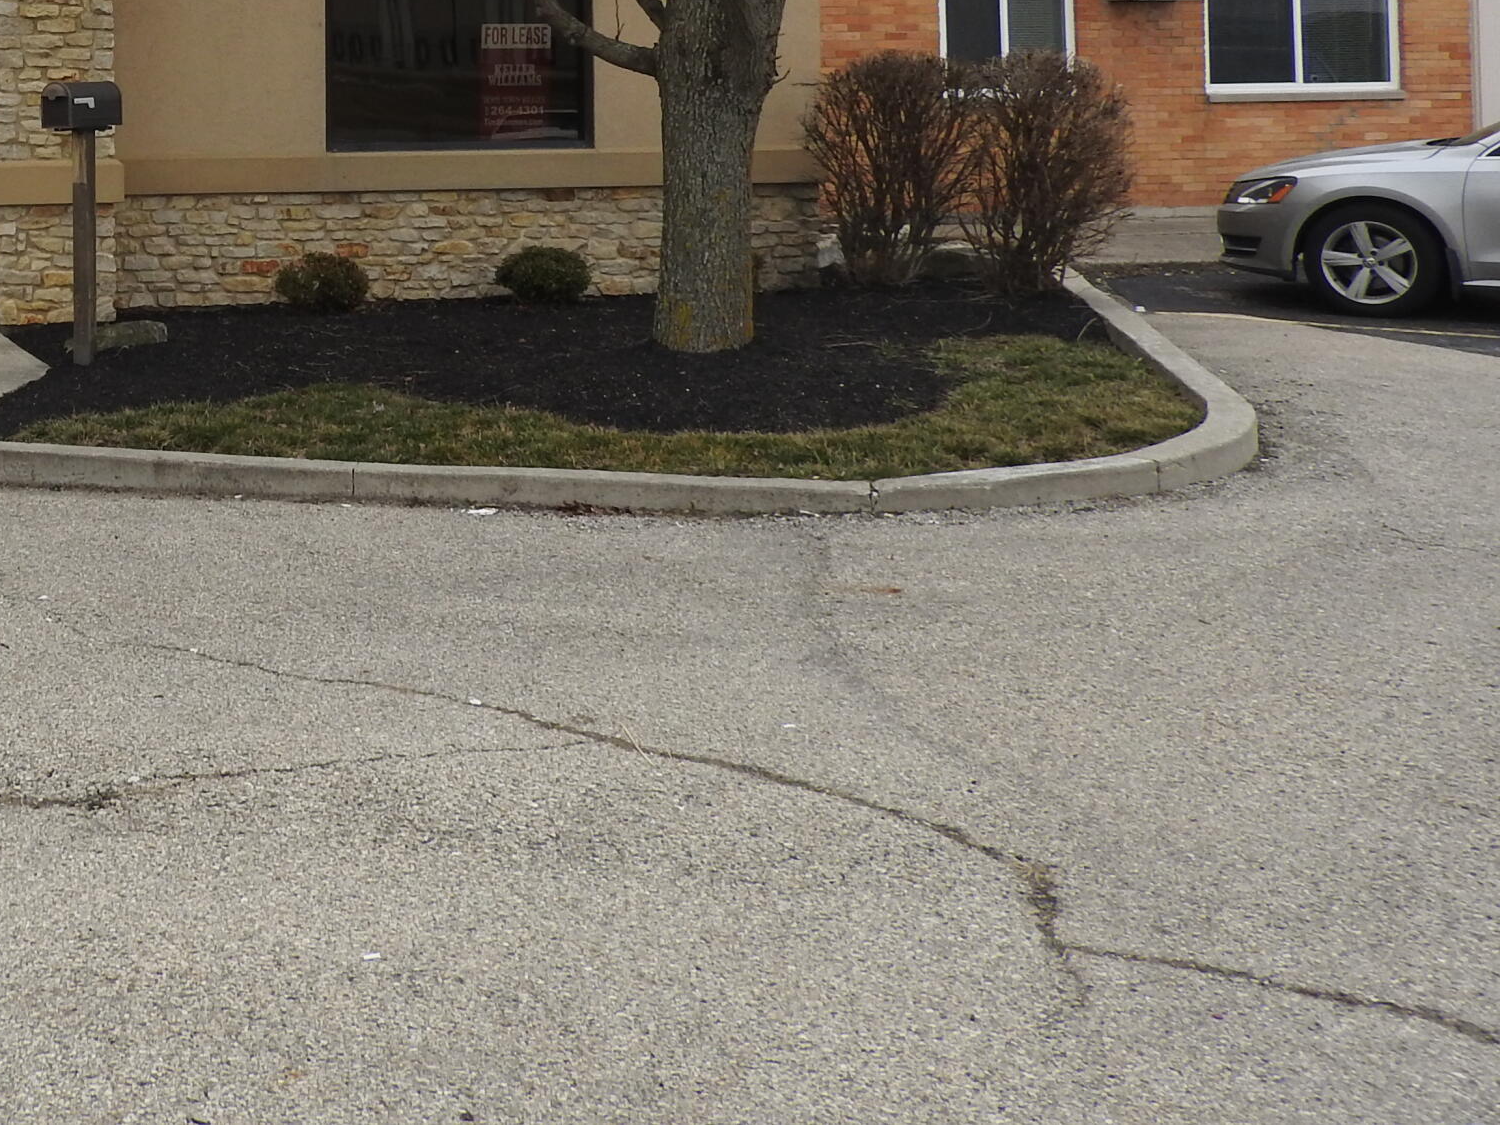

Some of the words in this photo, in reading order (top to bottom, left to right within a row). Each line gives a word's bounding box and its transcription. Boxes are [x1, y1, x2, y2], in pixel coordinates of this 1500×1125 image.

[484, 27, 508, 45] FOR
[512, 27, 549, 45] LEASE
[494, 64, 536, 75] KELLER
[488, 75, 542, 86] WILLIAMS
